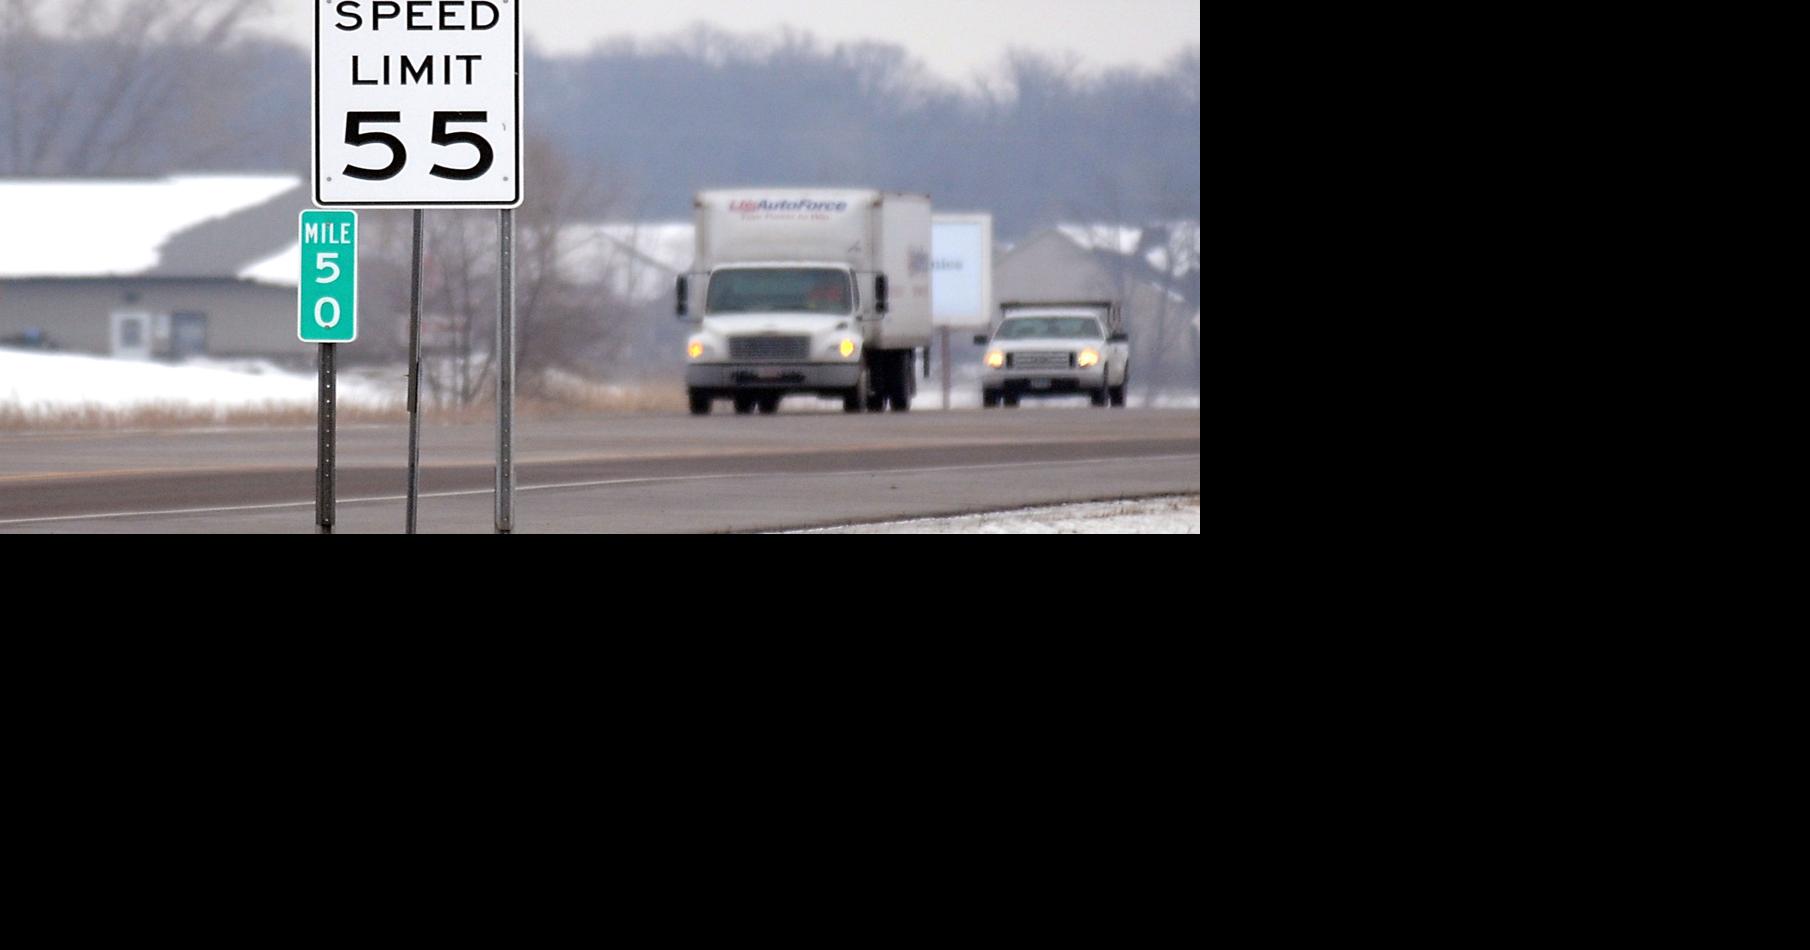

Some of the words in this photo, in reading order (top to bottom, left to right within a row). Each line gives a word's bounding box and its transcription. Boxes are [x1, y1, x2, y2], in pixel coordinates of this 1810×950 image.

[335, 0, 500, 31] SPEED
[352, 54, 482, 85] LIMIT
[342, 110, 494, 181] 55
[305, 222, 351, 244] MILE
[315, 252, 341, 284] 5
[314, 296, 341, 328] 0
